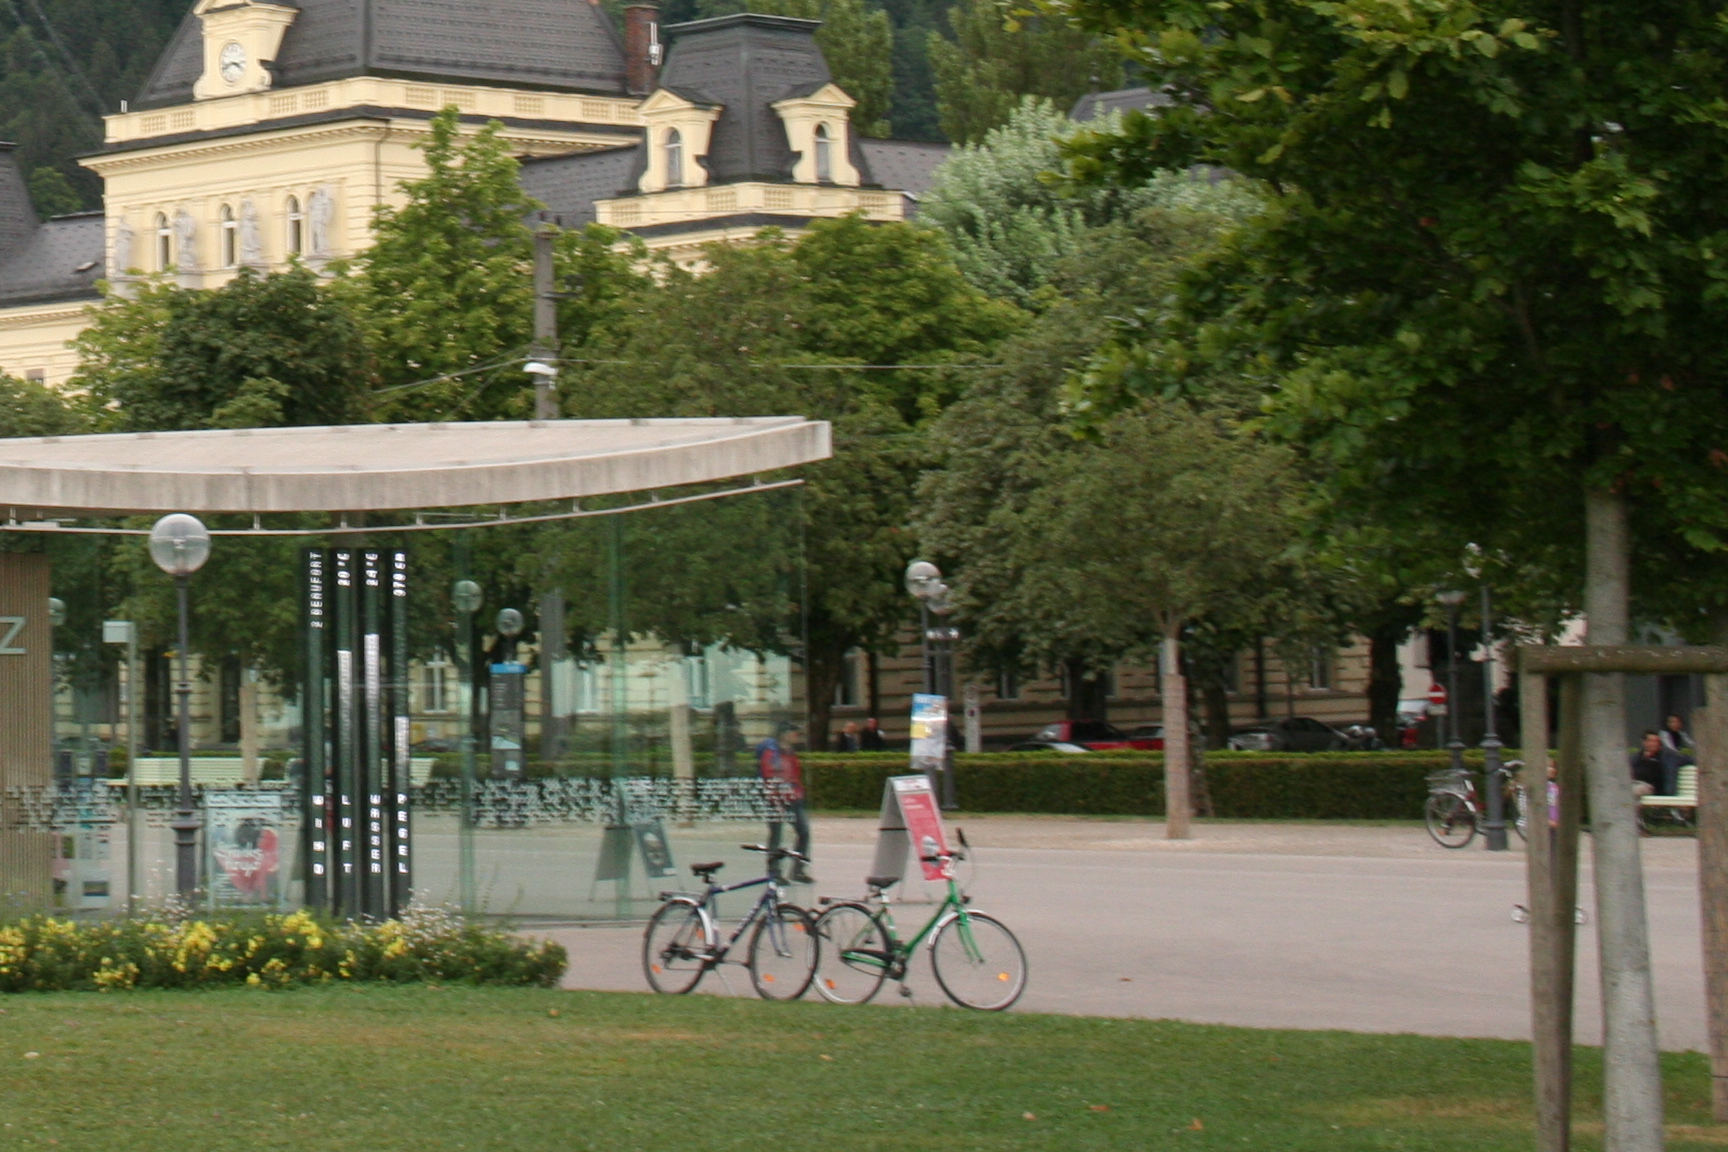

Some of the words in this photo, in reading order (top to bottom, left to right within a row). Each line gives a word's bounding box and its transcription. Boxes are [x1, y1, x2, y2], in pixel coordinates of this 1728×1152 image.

[309, 552, 323, 616] BEAUFORT
[341, 794, 353, 873] LUFT
[369, 794, 381, 873] WASSER
[397, 793, 409, 874] PEGEL
